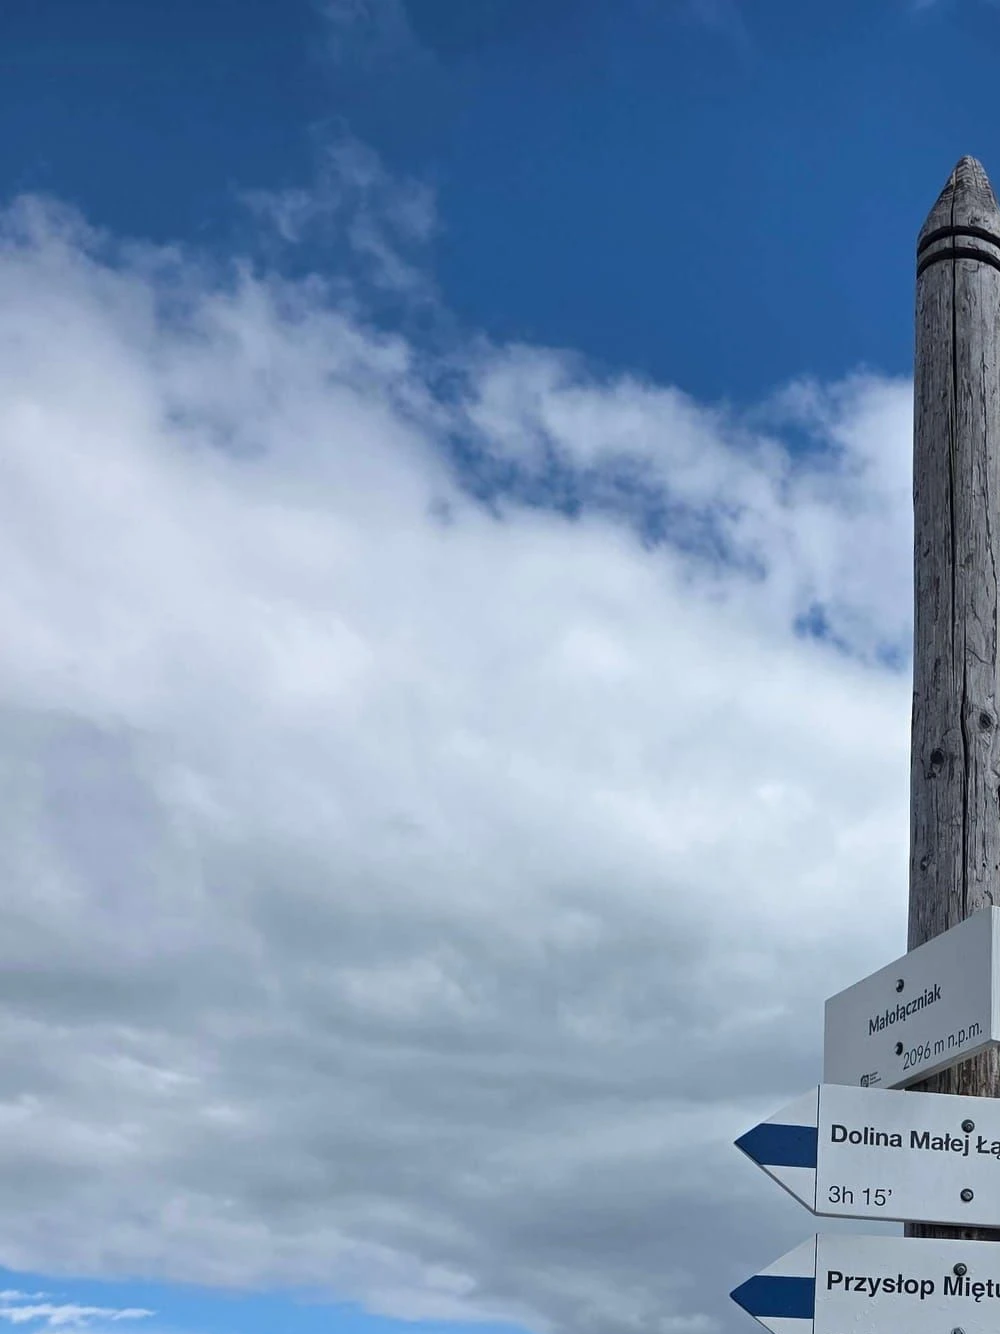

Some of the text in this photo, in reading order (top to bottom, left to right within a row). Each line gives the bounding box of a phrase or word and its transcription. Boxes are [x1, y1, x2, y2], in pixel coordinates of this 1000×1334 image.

[868, 984, 942, 1036] Małołączniak
[903, 1022, 983, 1070] 2096 m n.p.m.
[831, 1124, 902, 1148] Dolina
[910, 1130, 970, 1157] Małej
[828, 1185, 854, 1205] 3h
[827, 1270, 935, 1301] Przysłop
